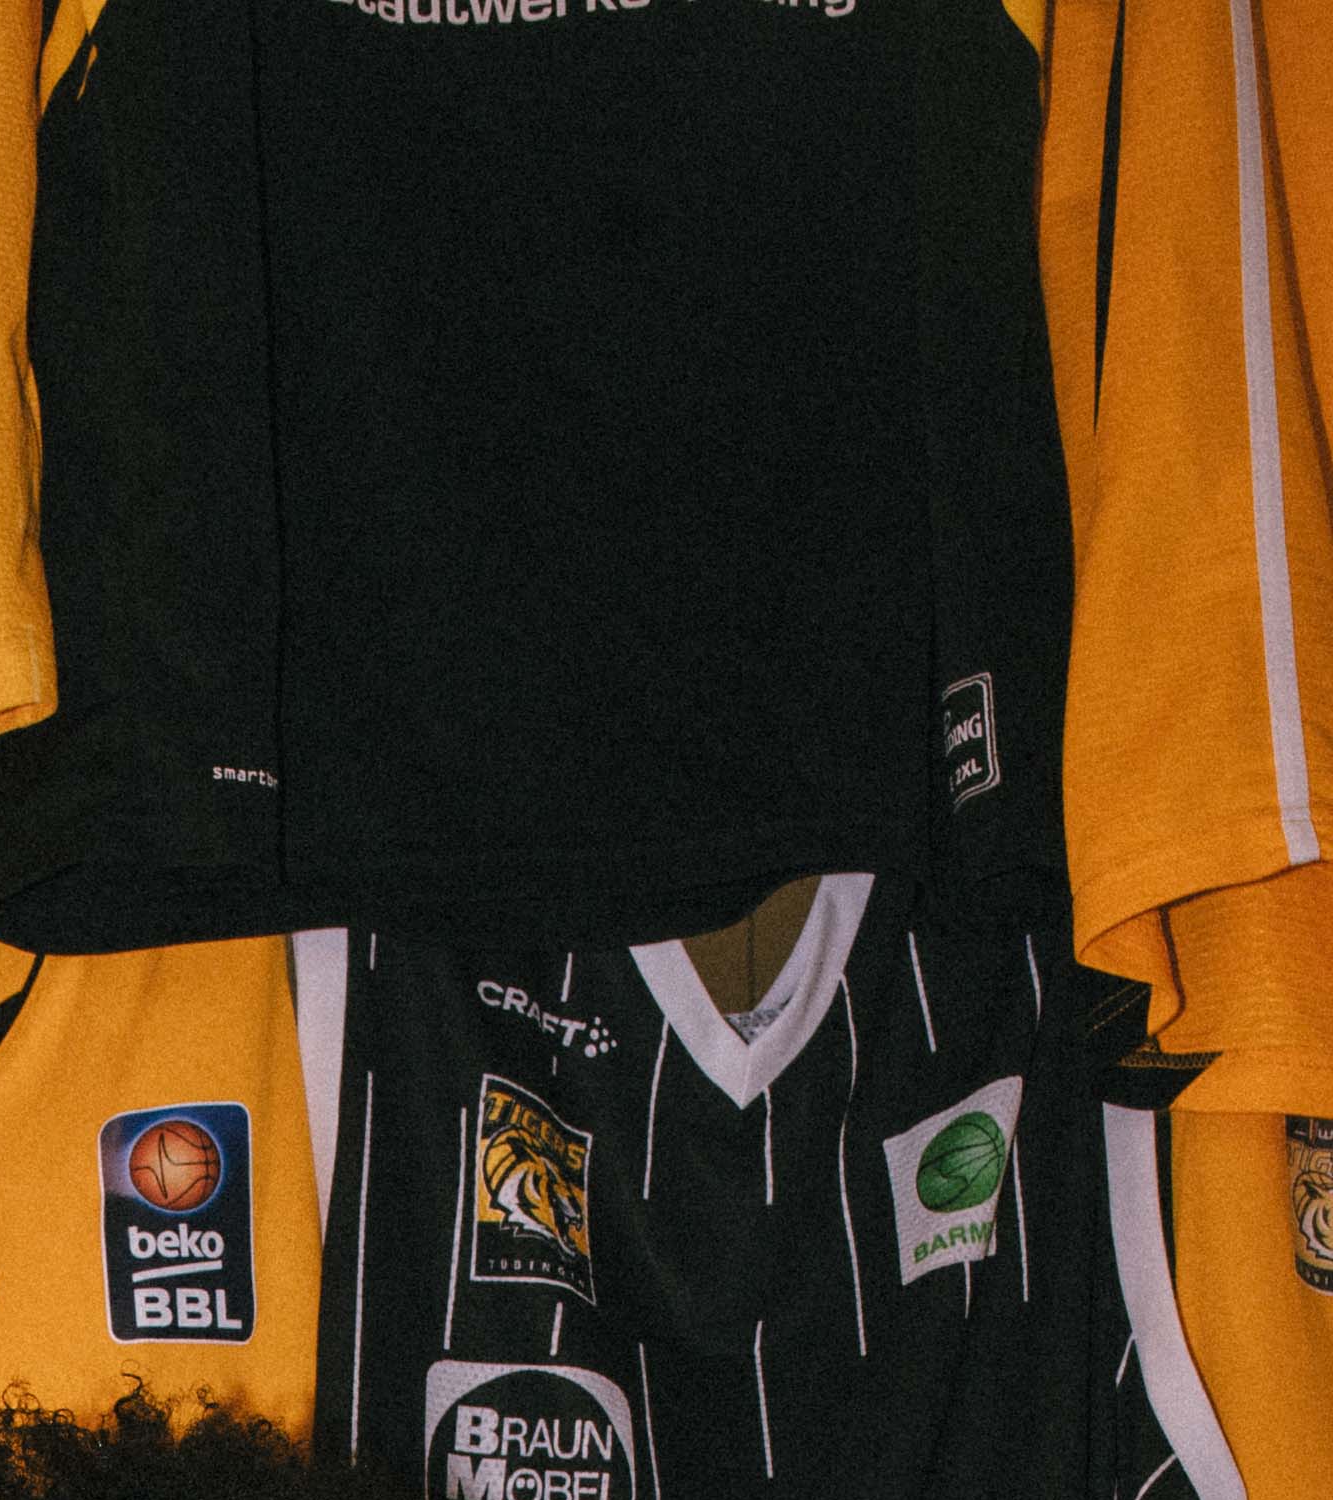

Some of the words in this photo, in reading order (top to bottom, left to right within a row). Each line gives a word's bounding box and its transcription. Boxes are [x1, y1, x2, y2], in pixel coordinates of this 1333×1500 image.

[213, 766, 278, 787] smartb
[477, 980, 587, 1047] CRAFT
[484, 1090, 586, 1171] TIGERS
[128, 1223, 225, 1259] beko
[915, 1221, 993, 1264] BARM
[133, 1287, 243, 1329] BBL
[454, 1405, 613, 1460] BRAUN
